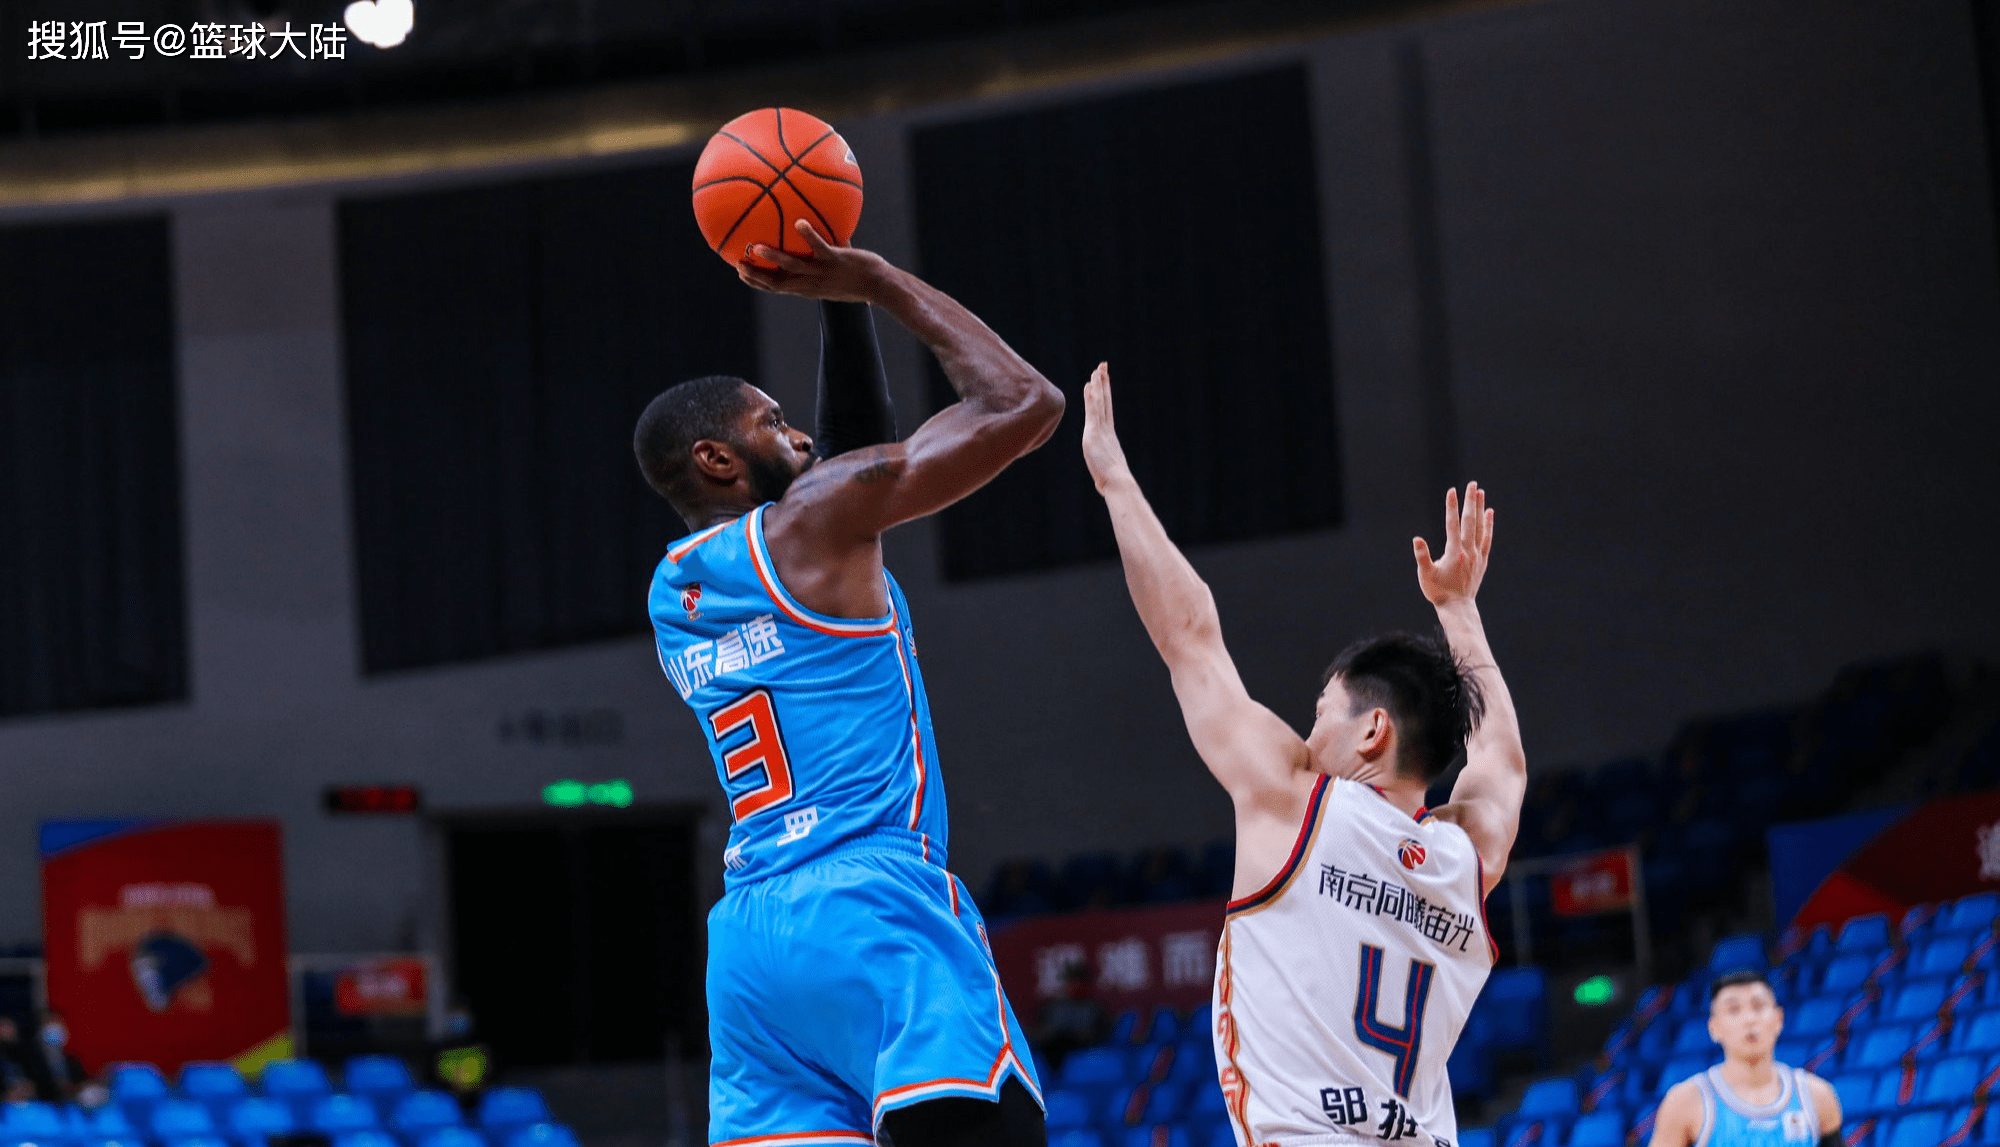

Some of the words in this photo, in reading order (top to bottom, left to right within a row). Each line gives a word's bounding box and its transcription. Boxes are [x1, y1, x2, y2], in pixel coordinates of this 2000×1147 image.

[667, 613, 786, 701] 山东高速
[709, 685, 796, 826] 3
[1318, 863, 1475, 952] 南京同曦宙光
[1352, 940, 1437, 1101] 4
